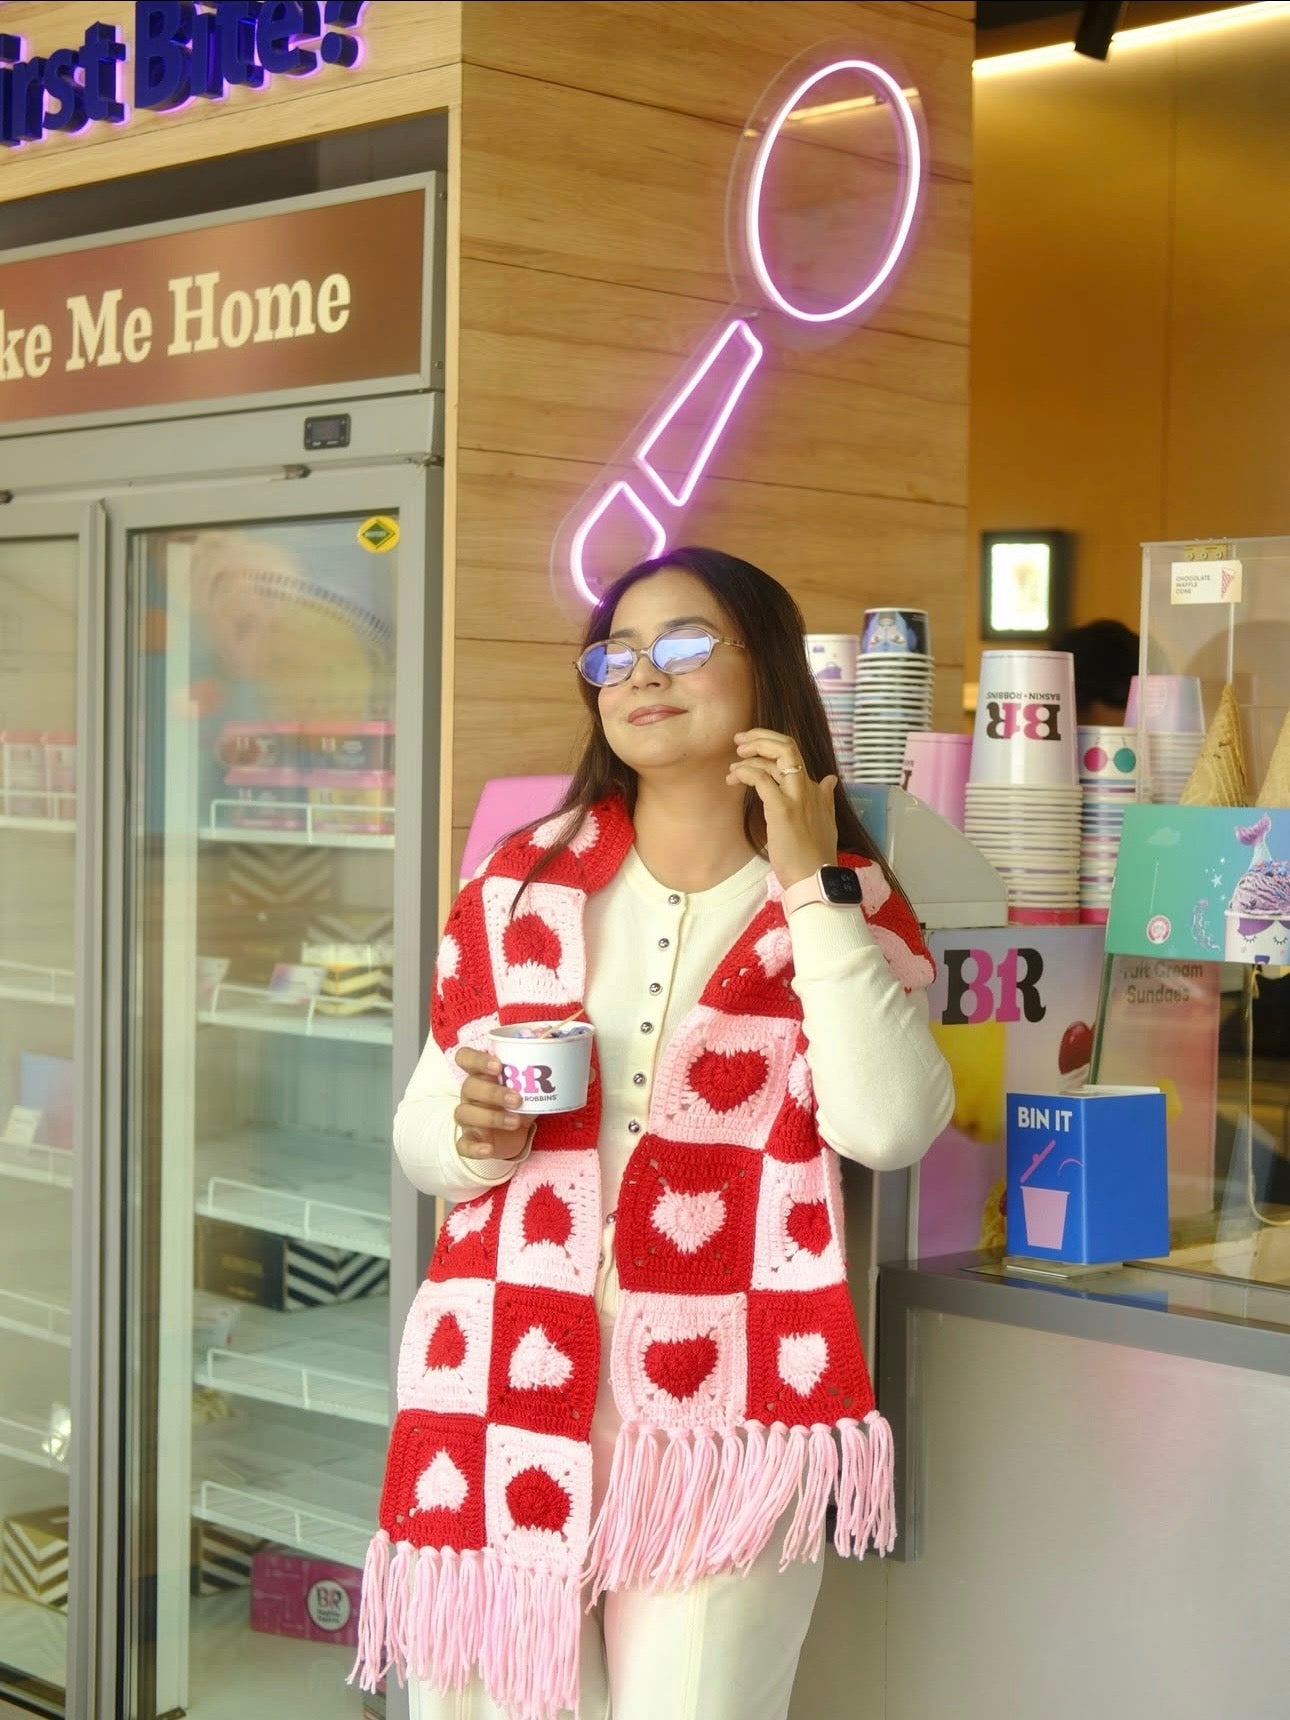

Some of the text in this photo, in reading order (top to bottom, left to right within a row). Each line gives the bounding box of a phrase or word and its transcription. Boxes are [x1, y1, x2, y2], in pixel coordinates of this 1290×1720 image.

[66, 288, 152, 372] Me
[167, 271, 351, 356] Home
[986, 691, 1061, 701] BASKIN ROBBINS
[524, 1094, 557, 1102] ROBBINS
[1018, 1106, 1073, 1132] BIN IT
